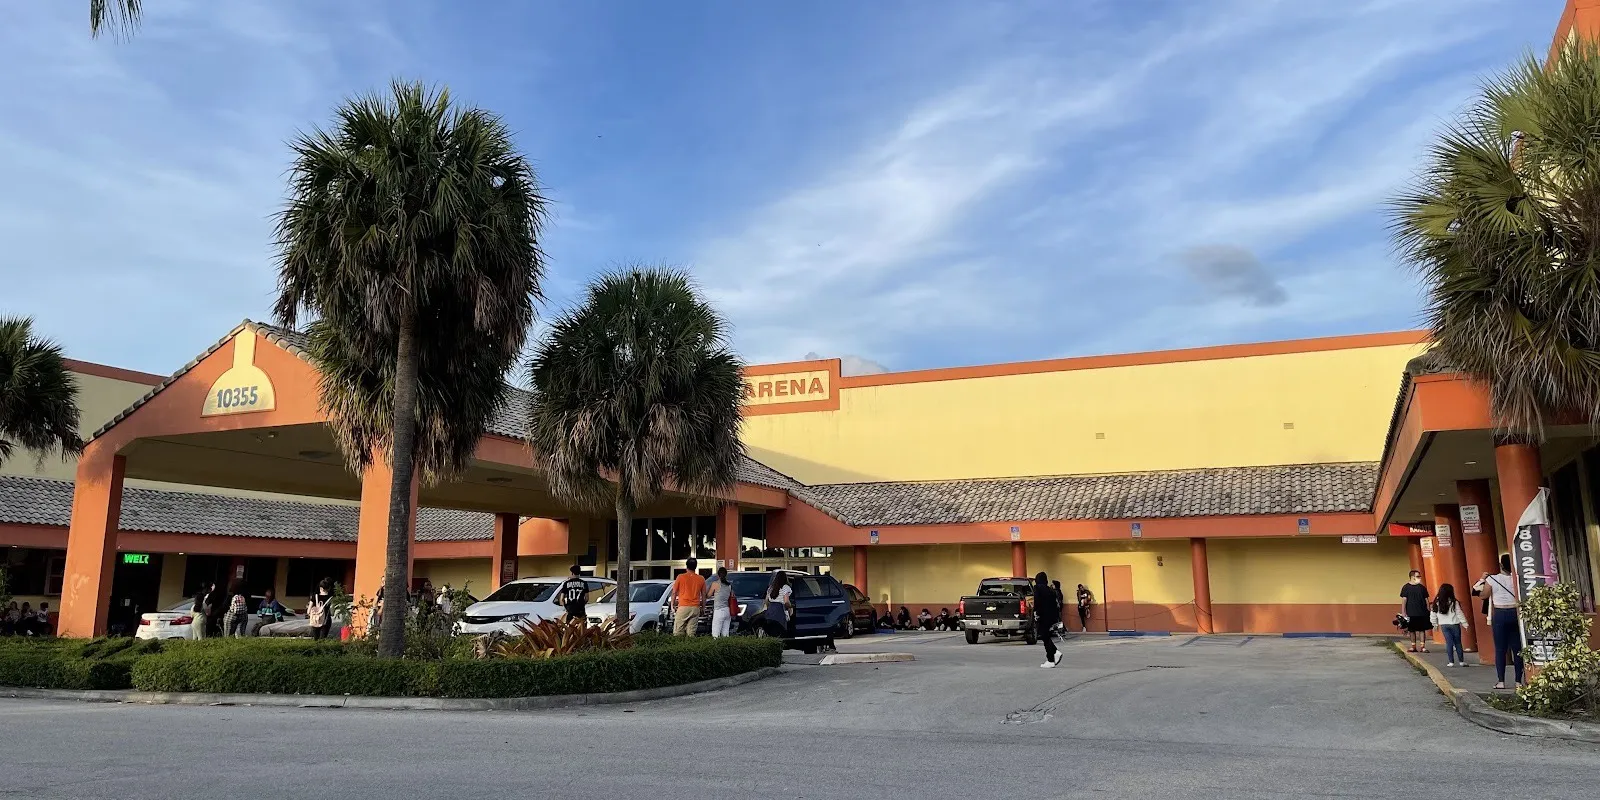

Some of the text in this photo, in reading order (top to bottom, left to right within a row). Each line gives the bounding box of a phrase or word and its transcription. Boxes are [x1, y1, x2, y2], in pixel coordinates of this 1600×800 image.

[217, 386, 258, 408] 10355
[744, 378, 824, 398] ARENA
[1519, 526, 1533, 551] 86
